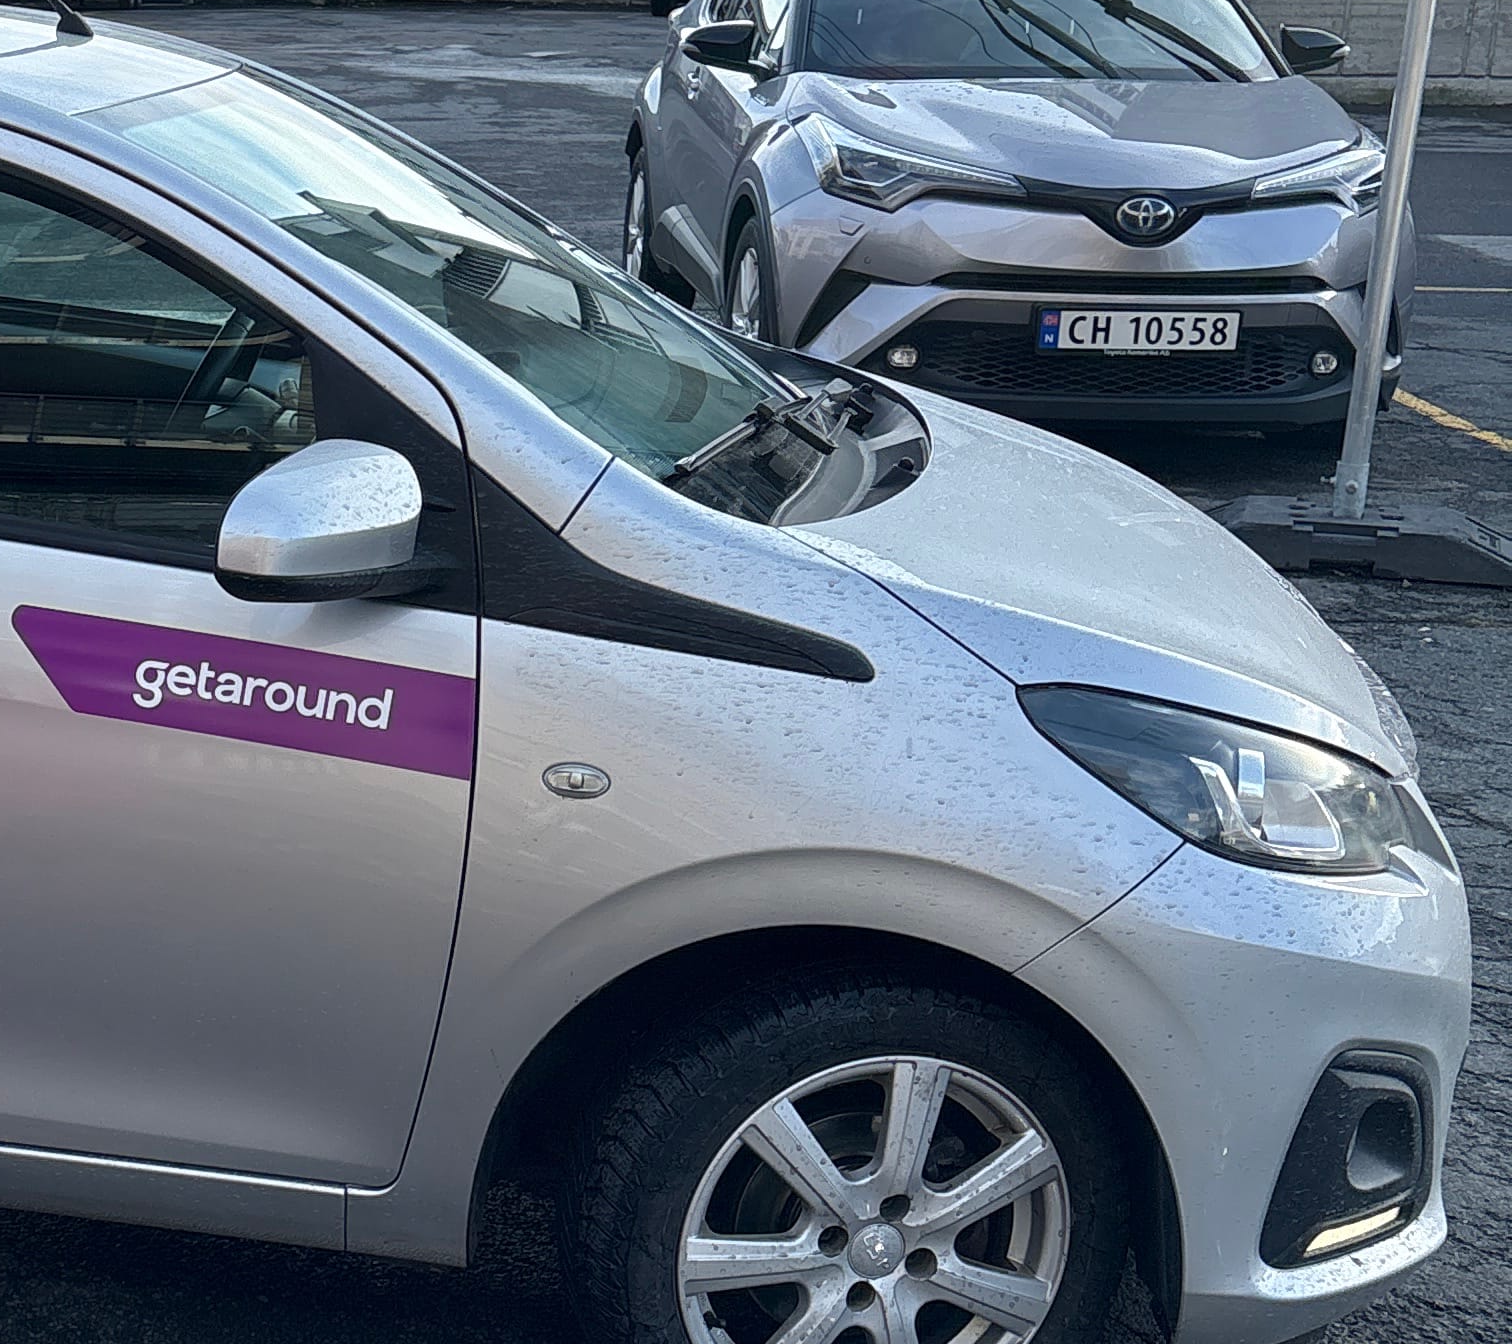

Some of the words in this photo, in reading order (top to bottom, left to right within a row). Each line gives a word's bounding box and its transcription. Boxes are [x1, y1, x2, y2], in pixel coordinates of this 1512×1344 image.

[1044, 334, 1054, 343] N
[1068, 316, 1112, 345] CH
[1129, 316, 1229, 346] 10558
[132, 659, 394, 730] getaround
